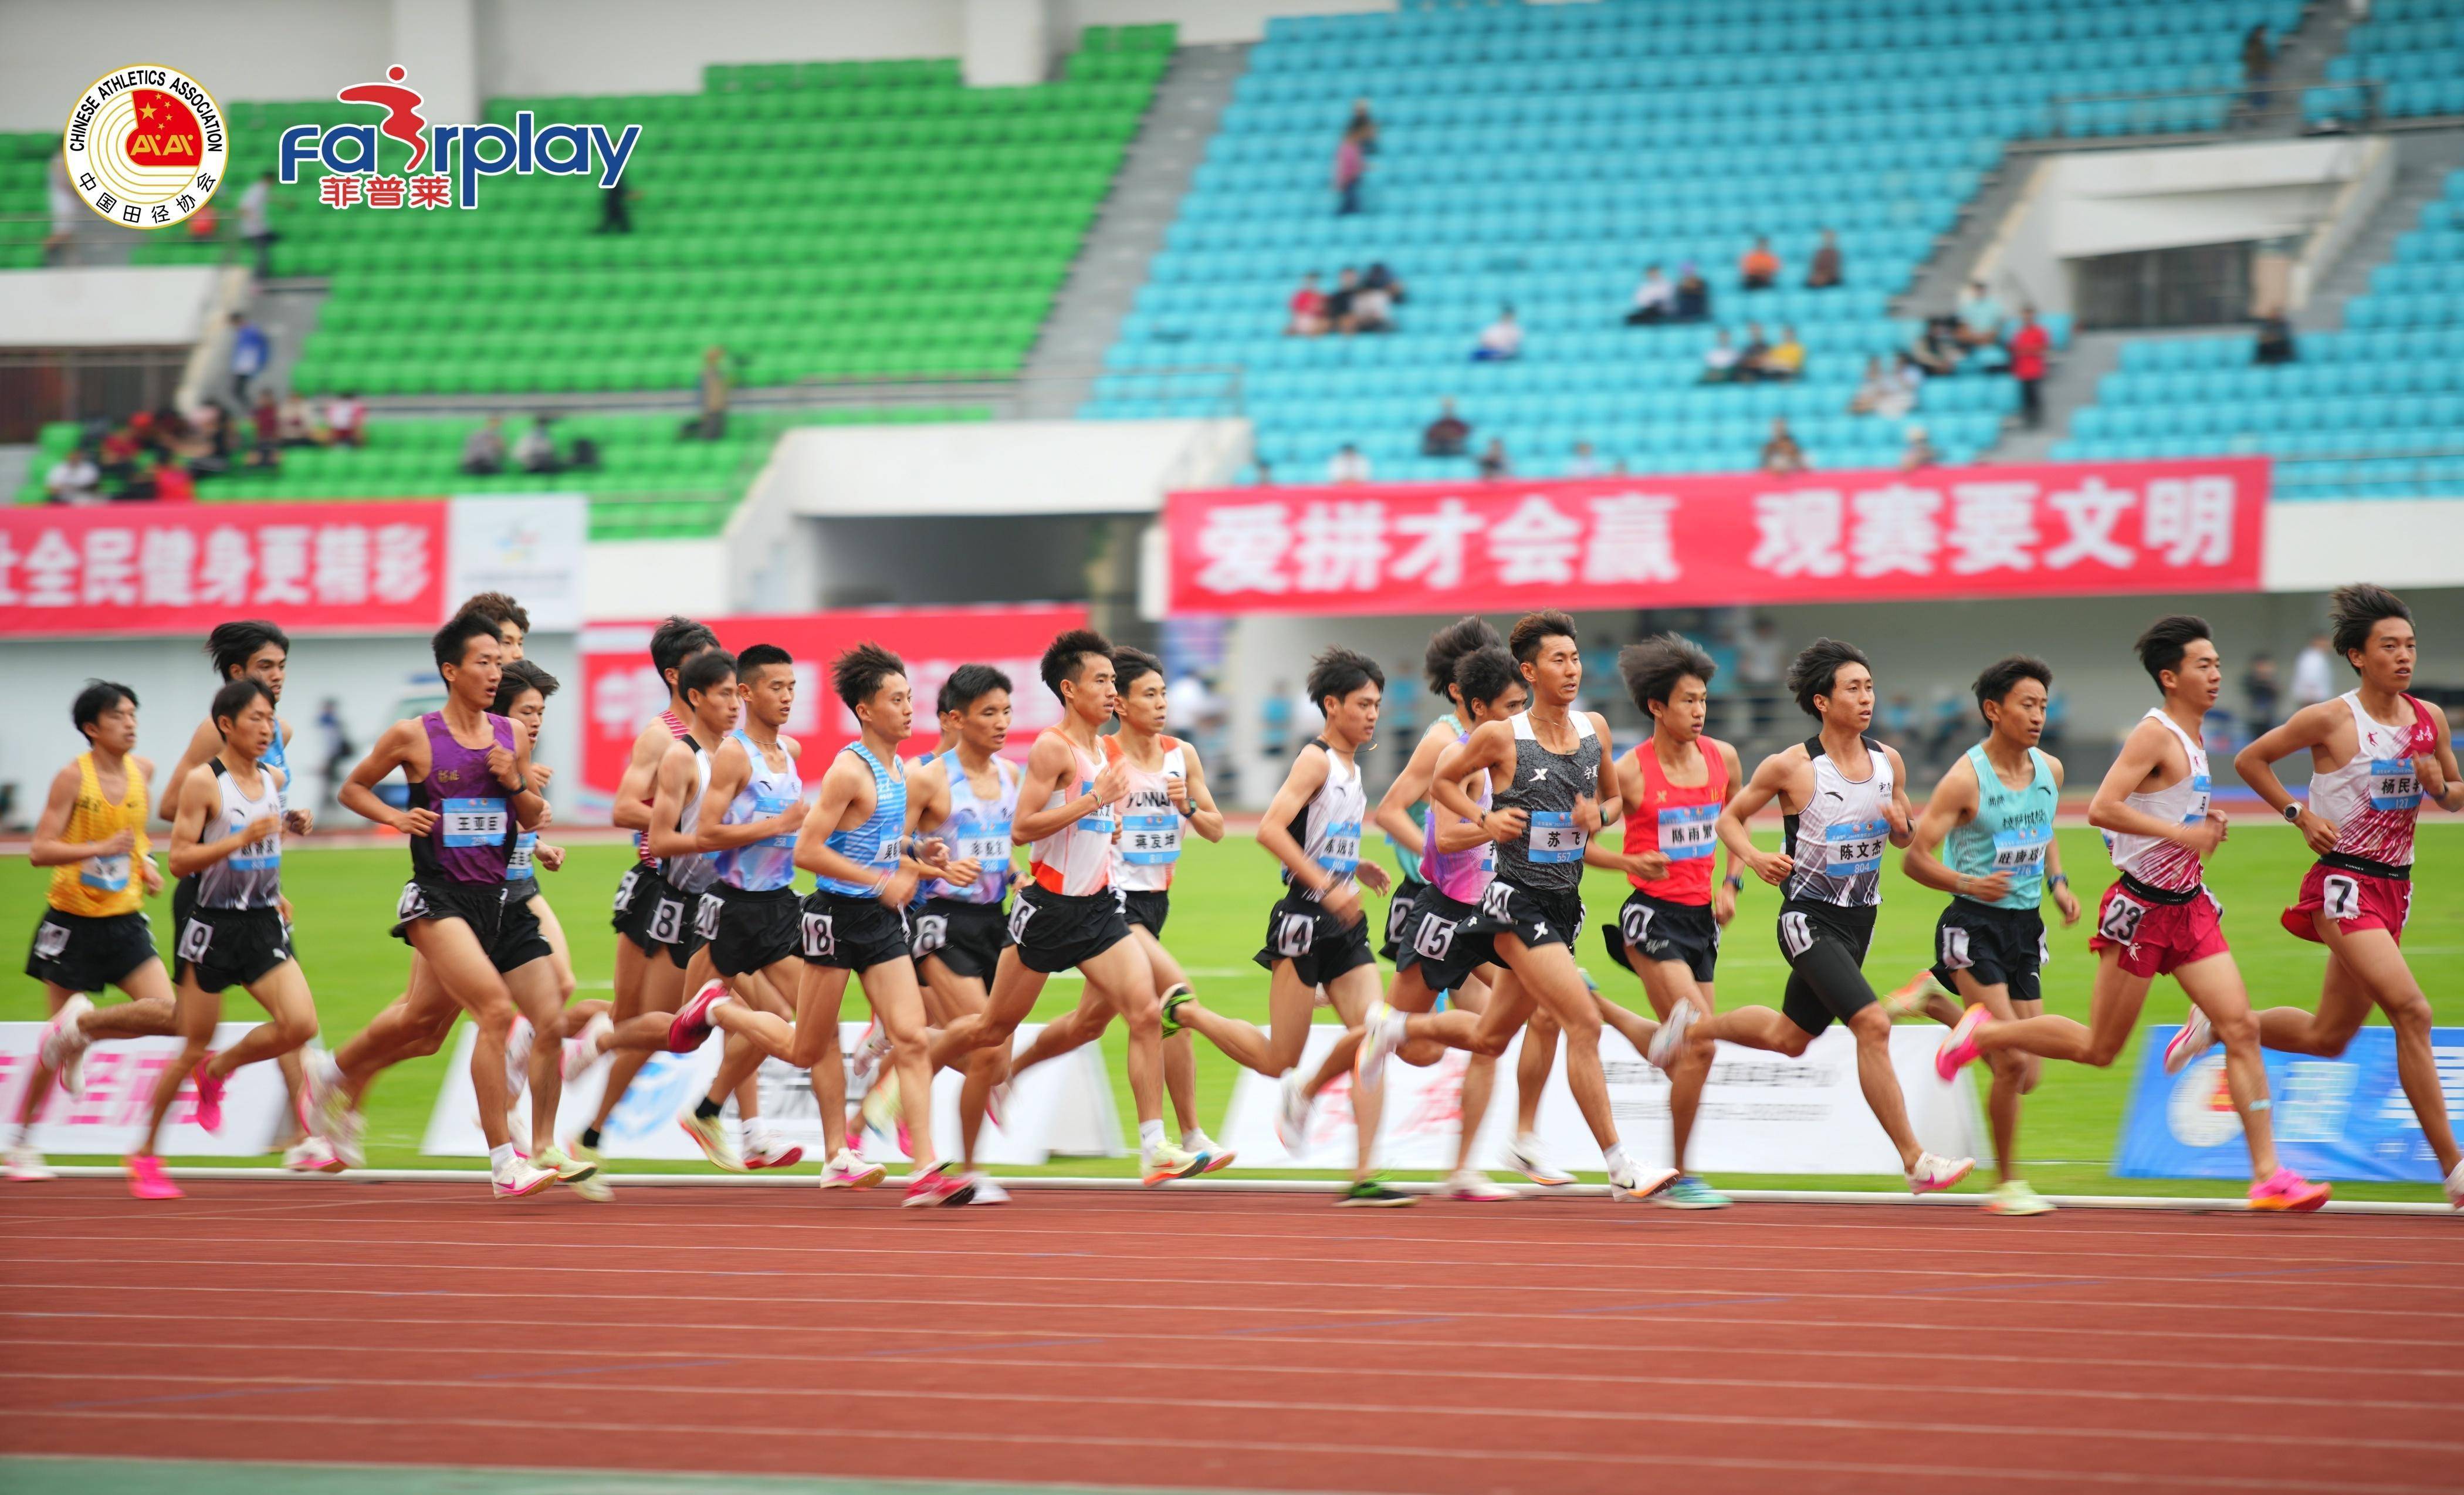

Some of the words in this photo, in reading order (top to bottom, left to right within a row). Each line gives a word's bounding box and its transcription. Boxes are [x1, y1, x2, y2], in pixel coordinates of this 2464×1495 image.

[1195, 492, 1680, 594] 爱拼才会赢
[1748, 475, 2235, 577] 观赛要文明
[2396, 799, 2409, 809] 127
[1548, 831, 1581, 847] 苏飞
[1840, 840, 1882, 860] 陈文杰
[1557, 852, 1571, 862] 557
[1854, 863, 1870, 874] 804
[2331, 879, 2353, 913] 7
[656, 904, 676, 938] 8
[805, 917, 830, 952] 18
[1281, 916, 1308, 953] 14
[1417, 916, 1453, 956] 15
[1785, 915, 1807, 953] 11
[2104, 899, 2141, 940] 23
